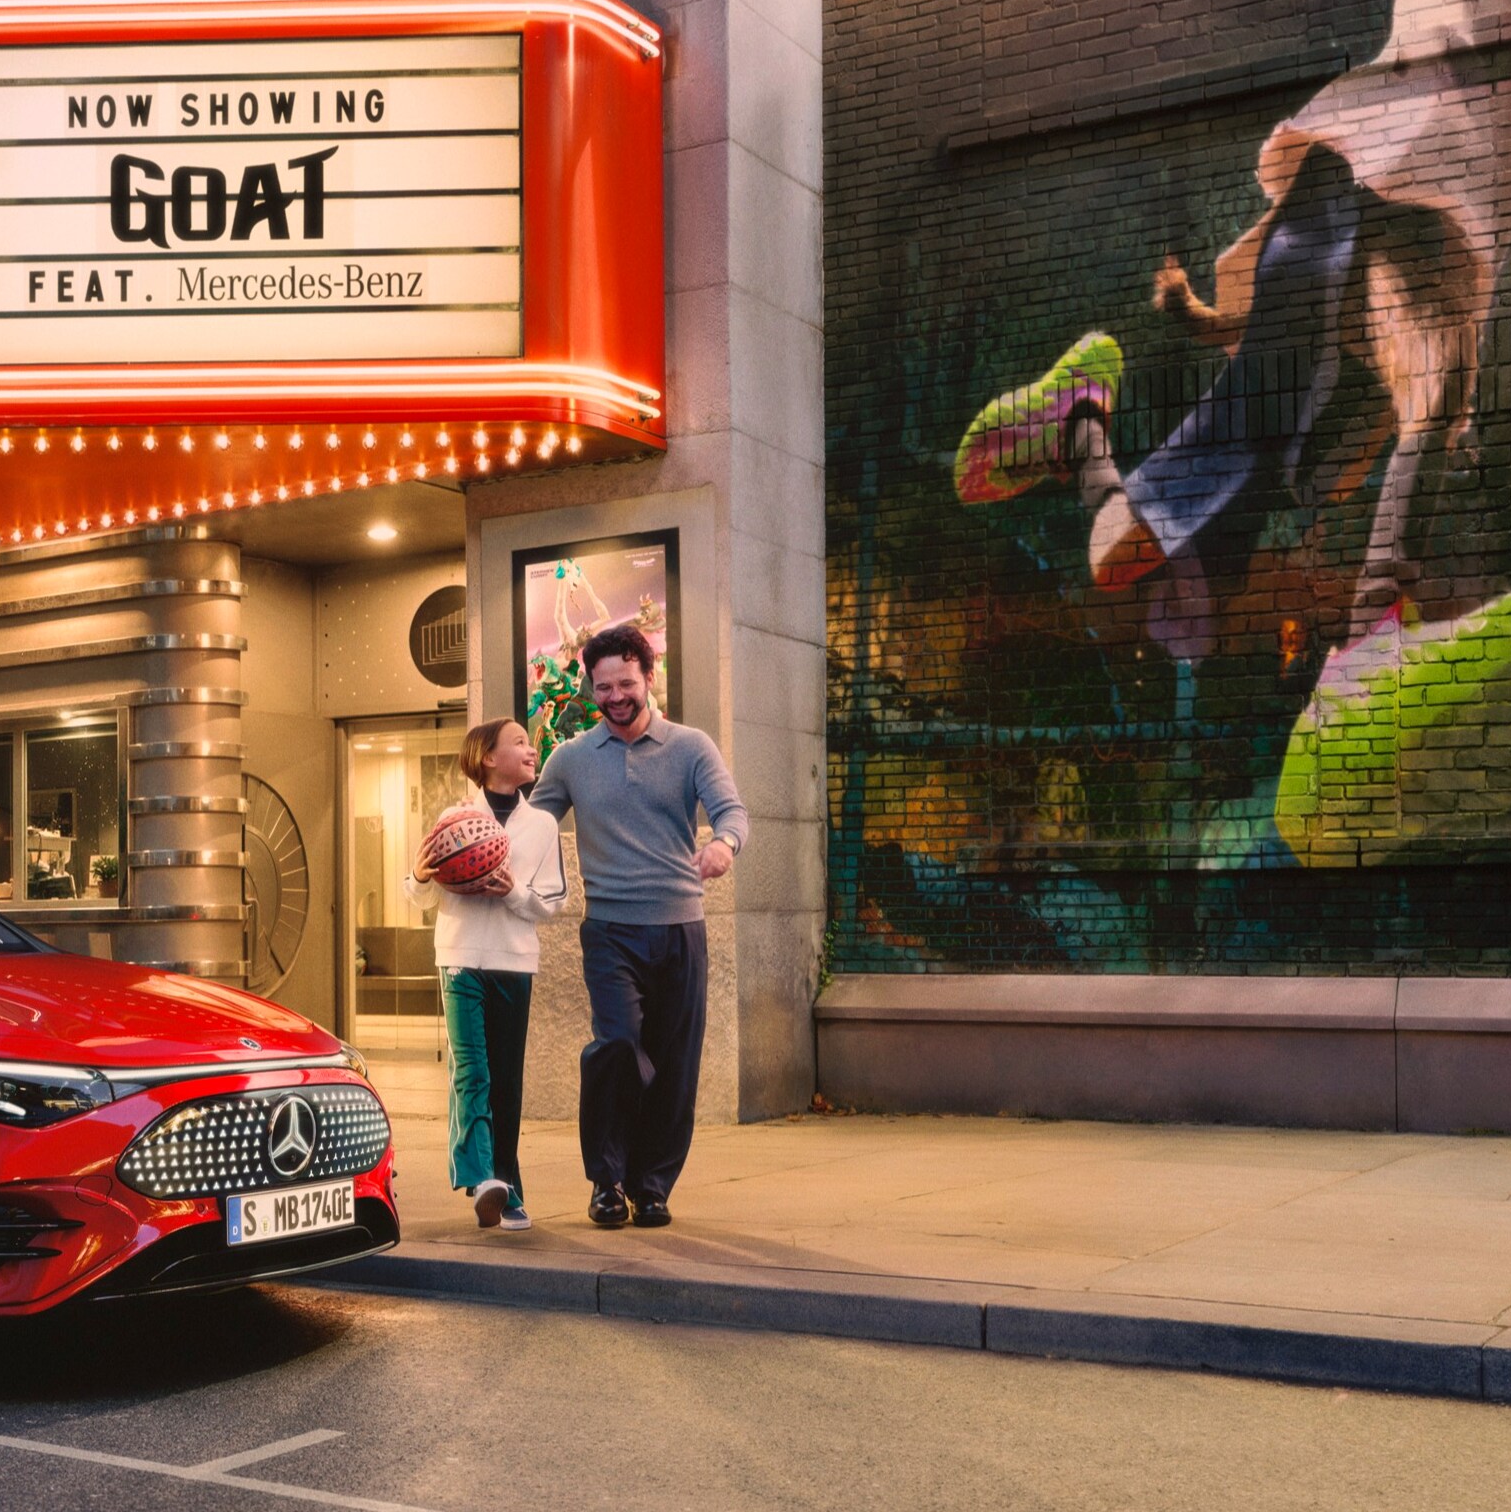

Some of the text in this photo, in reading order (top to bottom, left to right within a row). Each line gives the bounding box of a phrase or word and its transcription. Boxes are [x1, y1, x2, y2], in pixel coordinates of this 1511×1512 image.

[68, 89, 385, 128] NOW SHOWING
[110, 145, 339, 249] GOAT
[28, 264, 423, 303] FEAT. Mercedes-Benz
[244, 1200, 257, 1236] S
